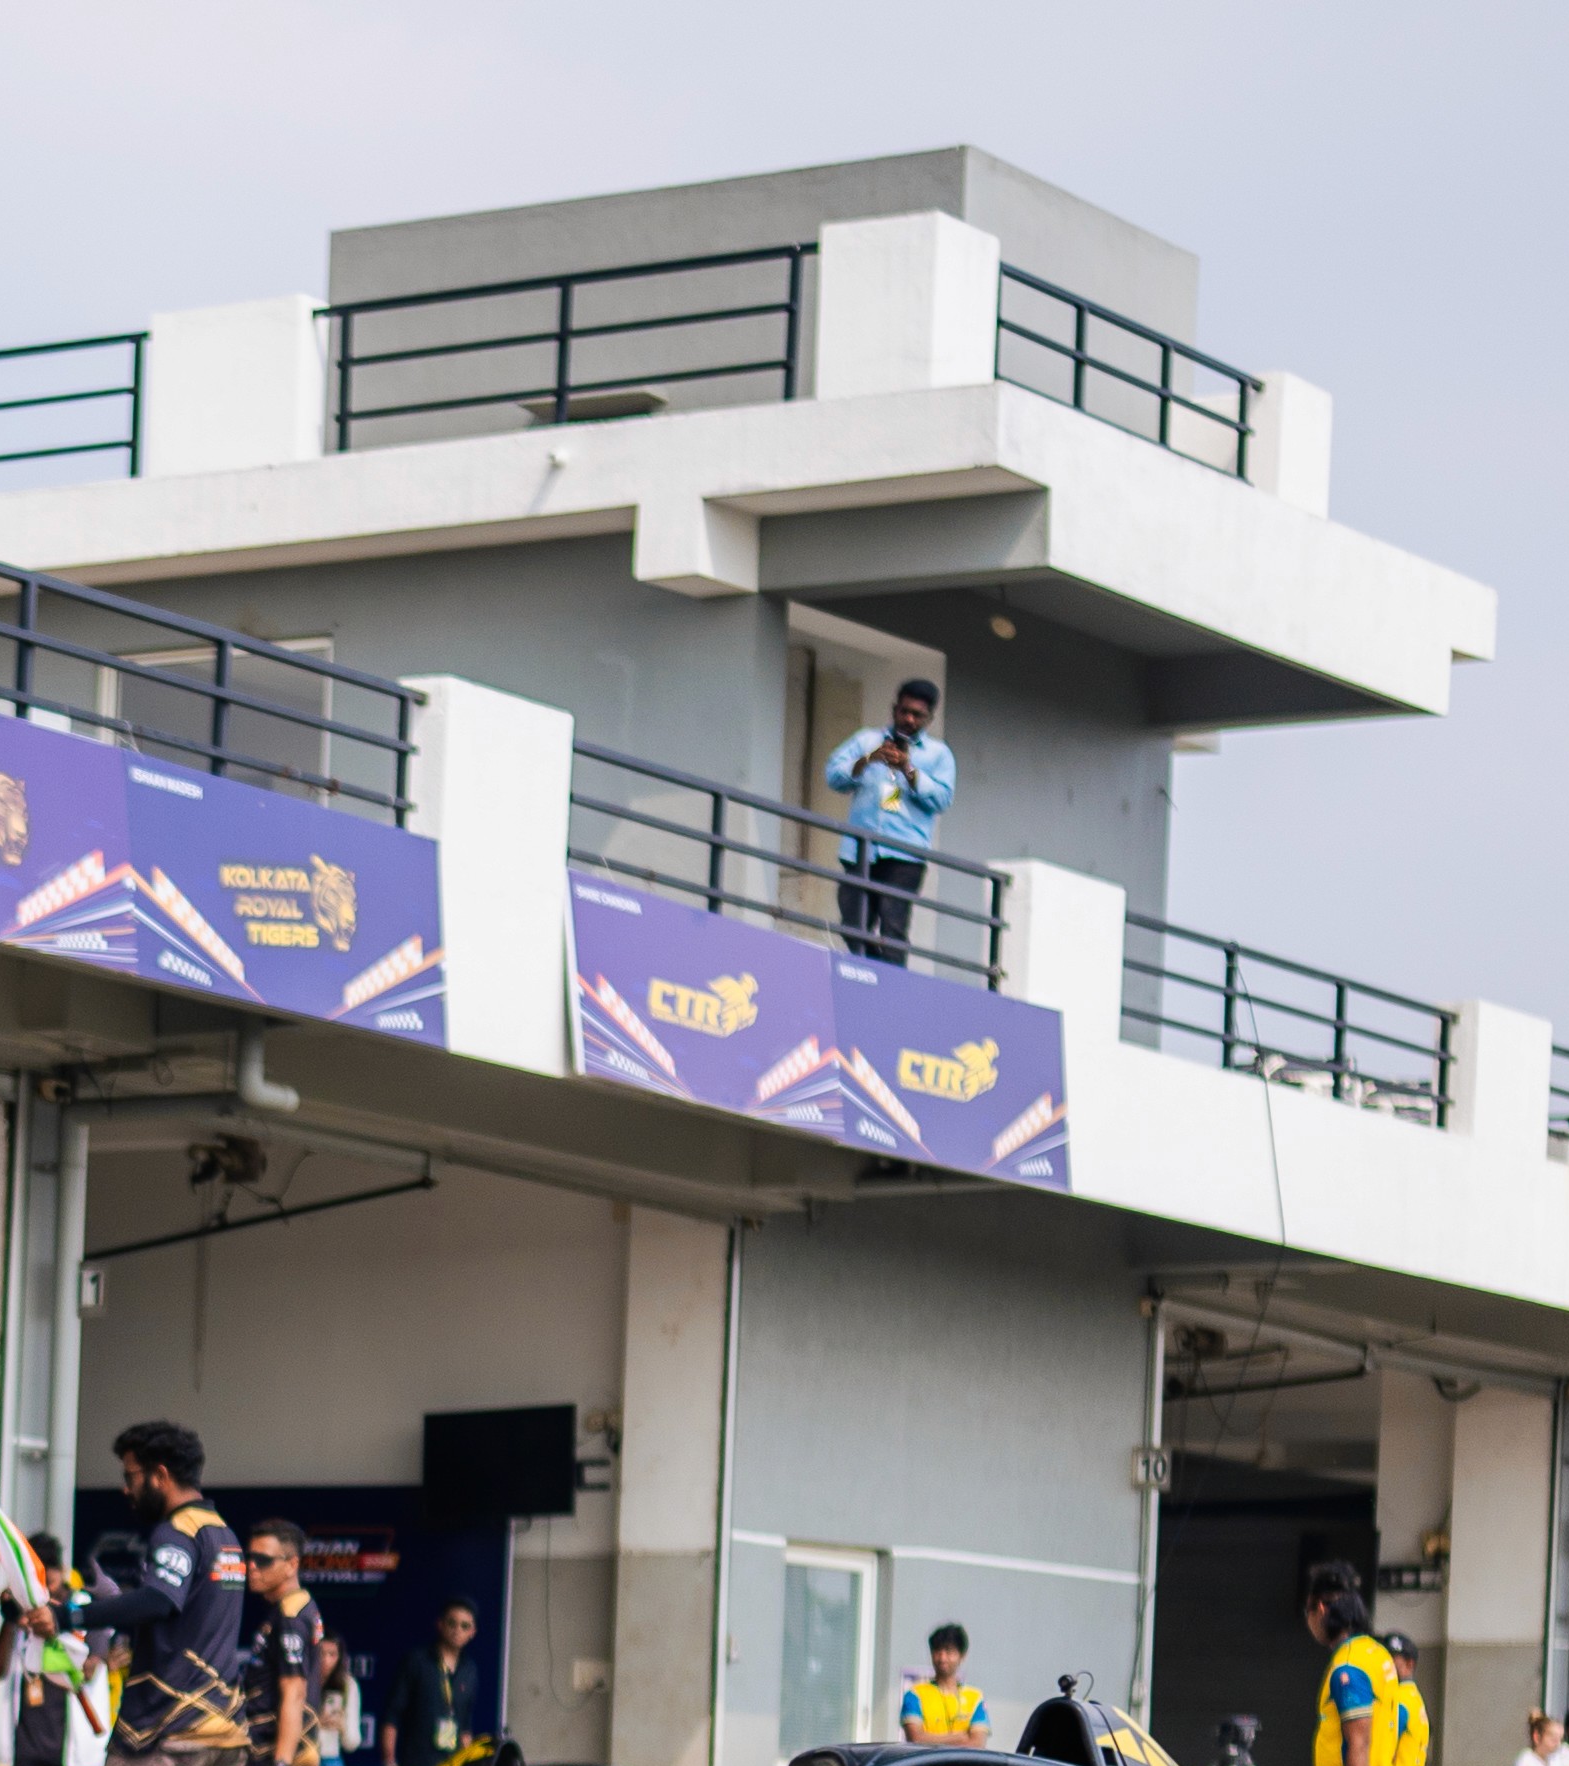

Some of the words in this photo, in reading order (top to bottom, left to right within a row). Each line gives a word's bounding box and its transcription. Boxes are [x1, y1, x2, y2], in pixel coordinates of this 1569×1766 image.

[220, 865, 311, 892] KOLKATA
[234, 895, 303, 919] ROYAL
[247, 922, 320, 948] TIGERS
[647, 978, 722, 1027] CTR
[899, 1048, 966, 1092] CTR
